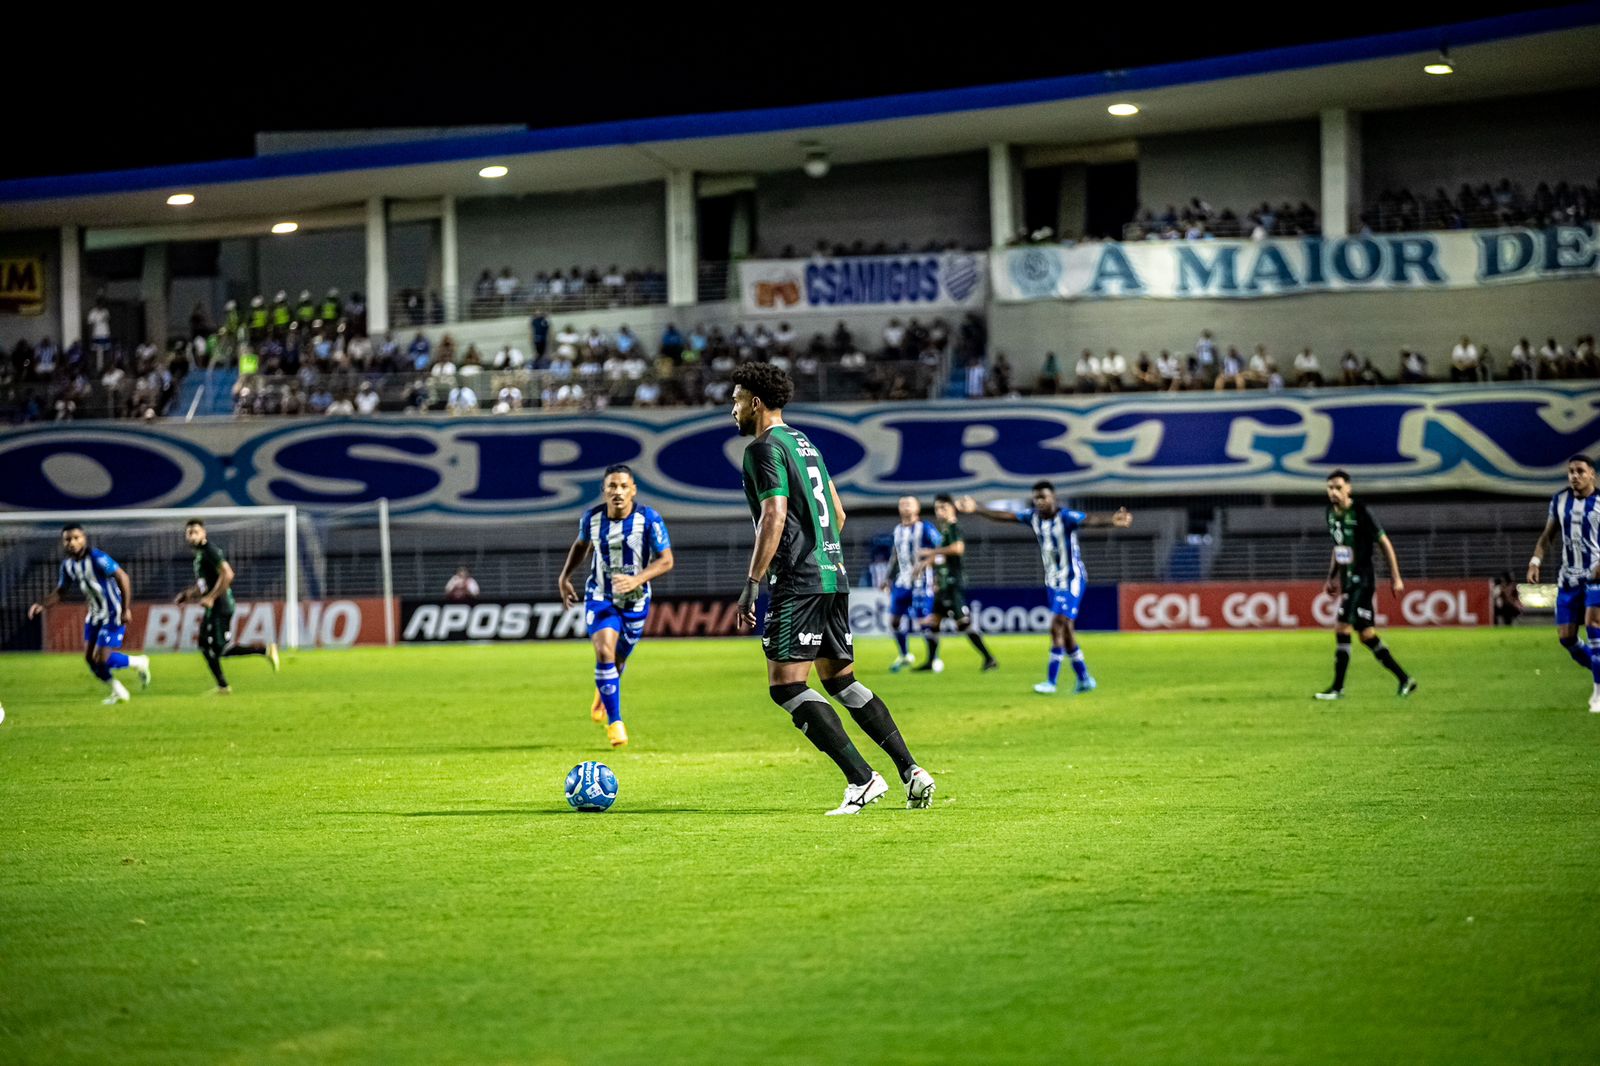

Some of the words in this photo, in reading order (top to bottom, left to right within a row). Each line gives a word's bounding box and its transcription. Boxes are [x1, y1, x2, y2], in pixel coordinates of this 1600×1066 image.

[1093, 243, 1142, 290] A
[1176, 235, 1443, 291] MAIOR
[1480, 222, 1599, 277] DE
[0, 263, 37, 292] M
[806, 258, 940, 306] CSAMIGOS
[806, 466, 831, 528] 3
[1133, 593, 1210, 628] GOL
[1222, 592, 1298, 628] GOL
[1312, 591, 1389, 627] GL
[1402, 589, 1479, 626] GOL
